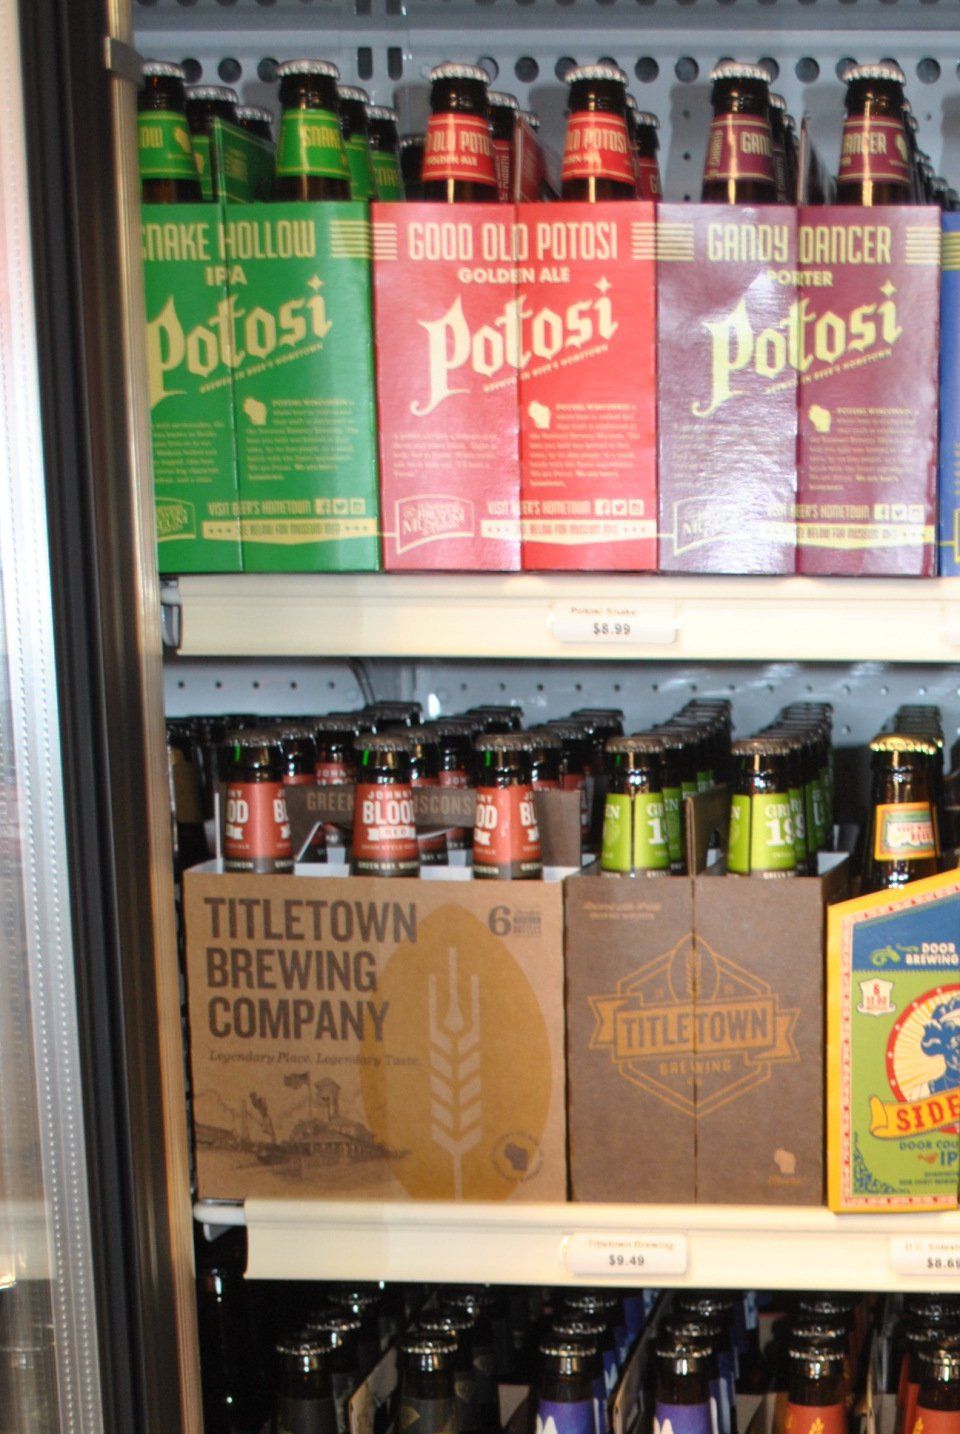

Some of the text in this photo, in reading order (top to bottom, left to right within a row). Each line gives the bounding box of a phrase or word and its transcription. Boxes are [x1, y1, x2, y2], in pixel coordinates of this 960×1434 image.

[217, 219, 316, 259] HOLLOW
[408, 222, 618, 261] GOOD OLD POTOSI
[708, 225, 892, 265] GANDY DANCER
[205, 265, 248, 286] IPA
[458, 266, 571, 284] GOLDEN ALE
[767, 270, 834, 288] PORTER
[146, 274, 333, 411] Potosi
[411, 275, 620, 416] Potosi
[691, 280, 903, 418] Potosi
[593, 622, 631, 635] $8.99
[204, 897, 418, 944] TITLETOWN
[488, 904, 512, 937] 6
[906, 953, 960, 966] BREWING
[920, 942, 956, 954] DOOR
[206, 947, 378, 992] BREWING
[208, 996, 390, 1042] COMPANY
[621, 1006, 769, 1050] TITLETOWN
[208, 1049, 275, 1066] Legendary
[315, 1052, 382, 1067] Legendary
[659, 1058, 732, 1077] BREWING
